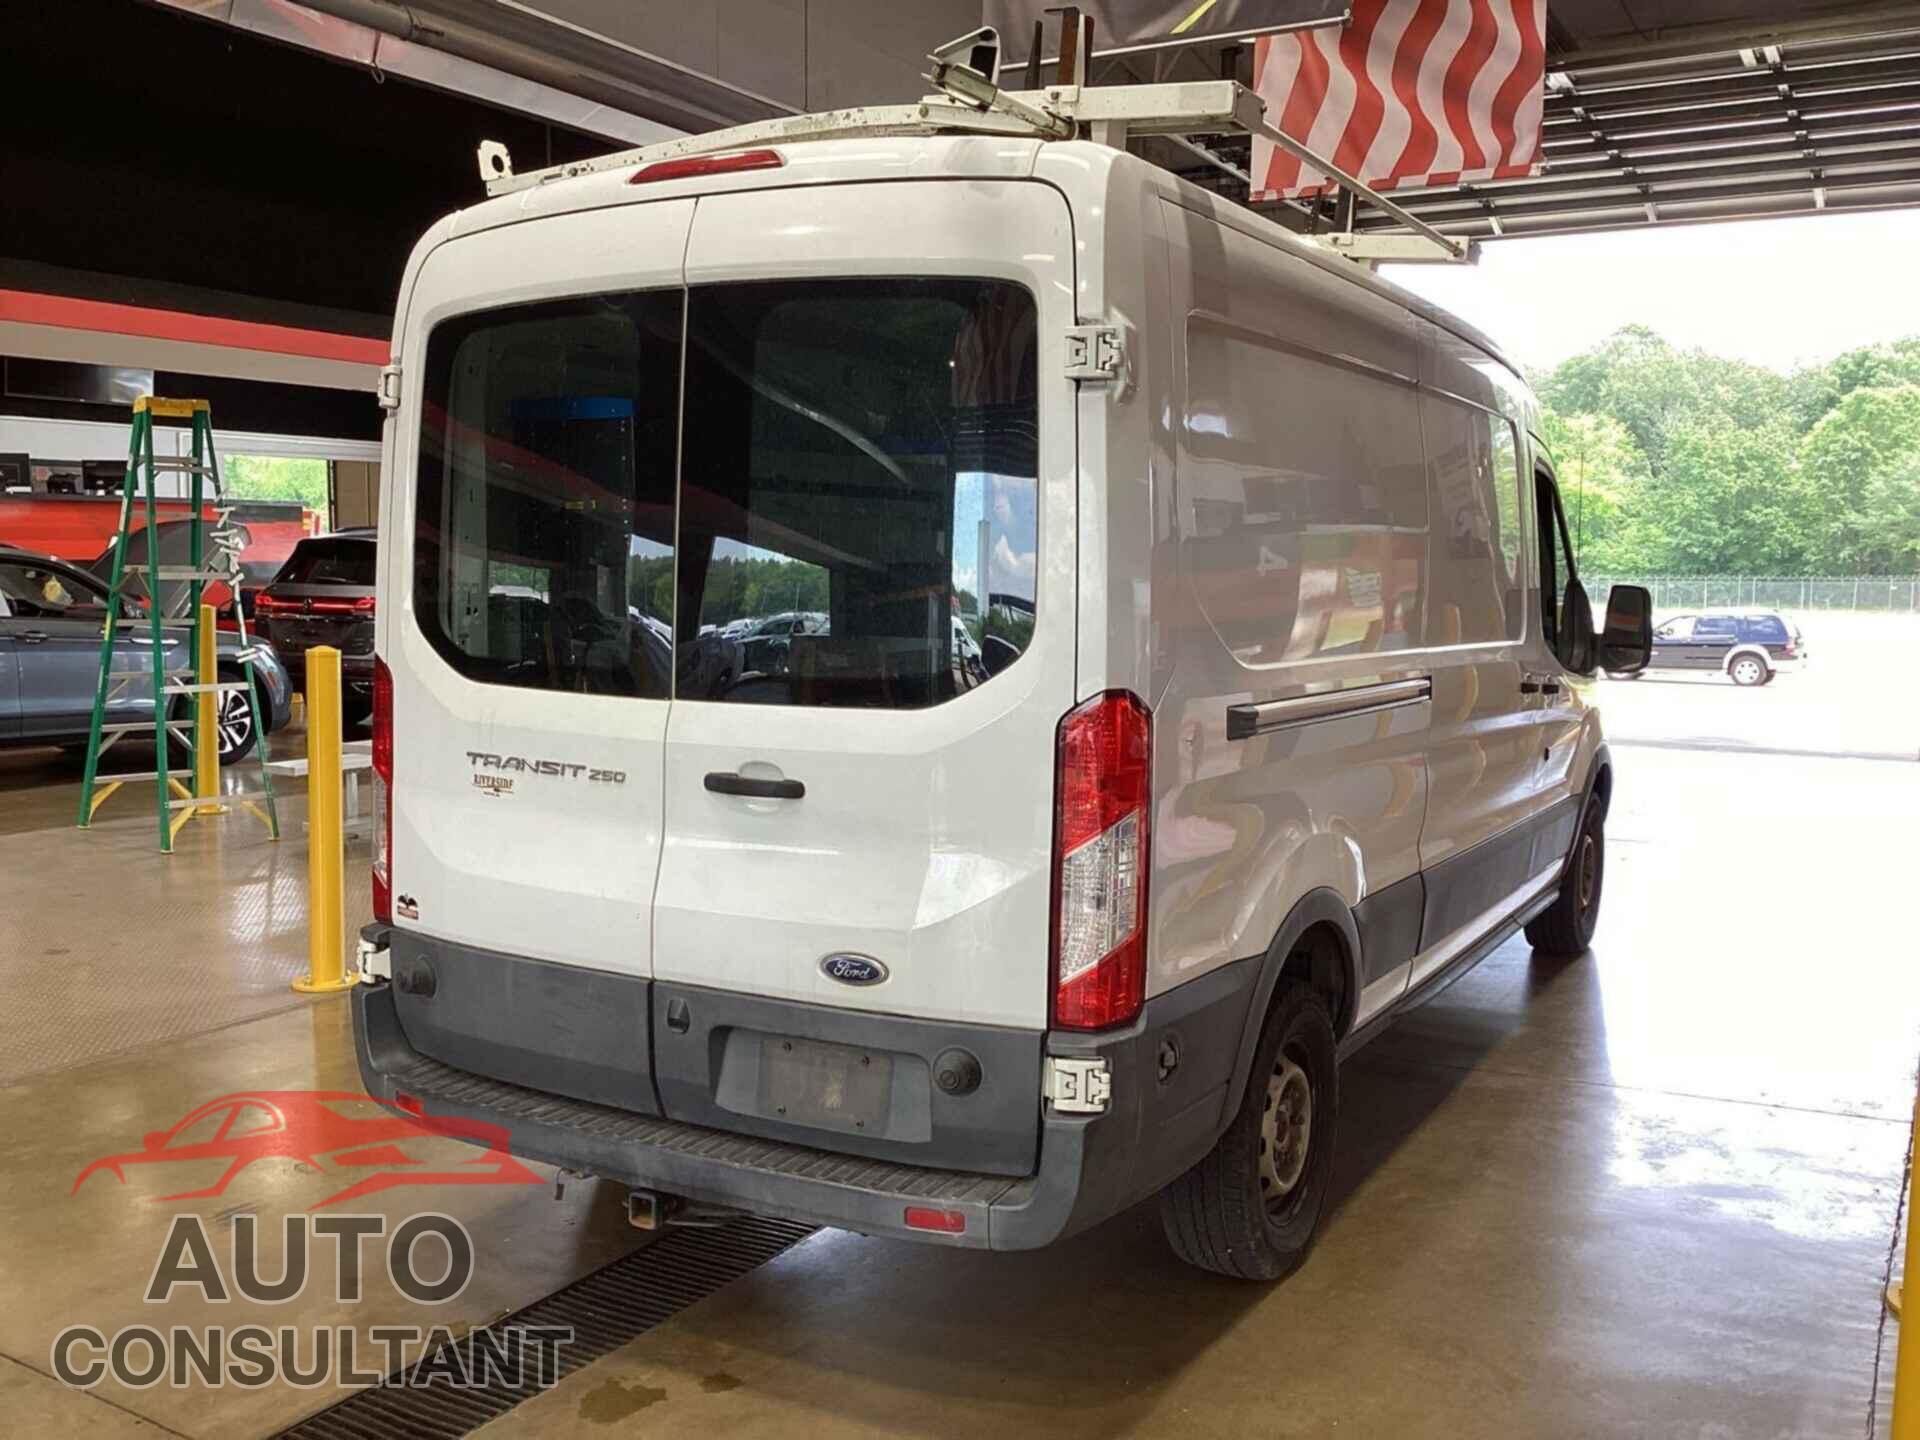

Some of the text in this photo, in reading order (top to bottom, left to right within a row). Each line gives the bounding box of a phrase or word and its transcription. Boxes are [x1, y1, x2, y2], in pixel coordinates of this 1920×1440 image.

[466, 751, 627, 784] TRANSIT 250
[833, 959, 871, 977] Ford
